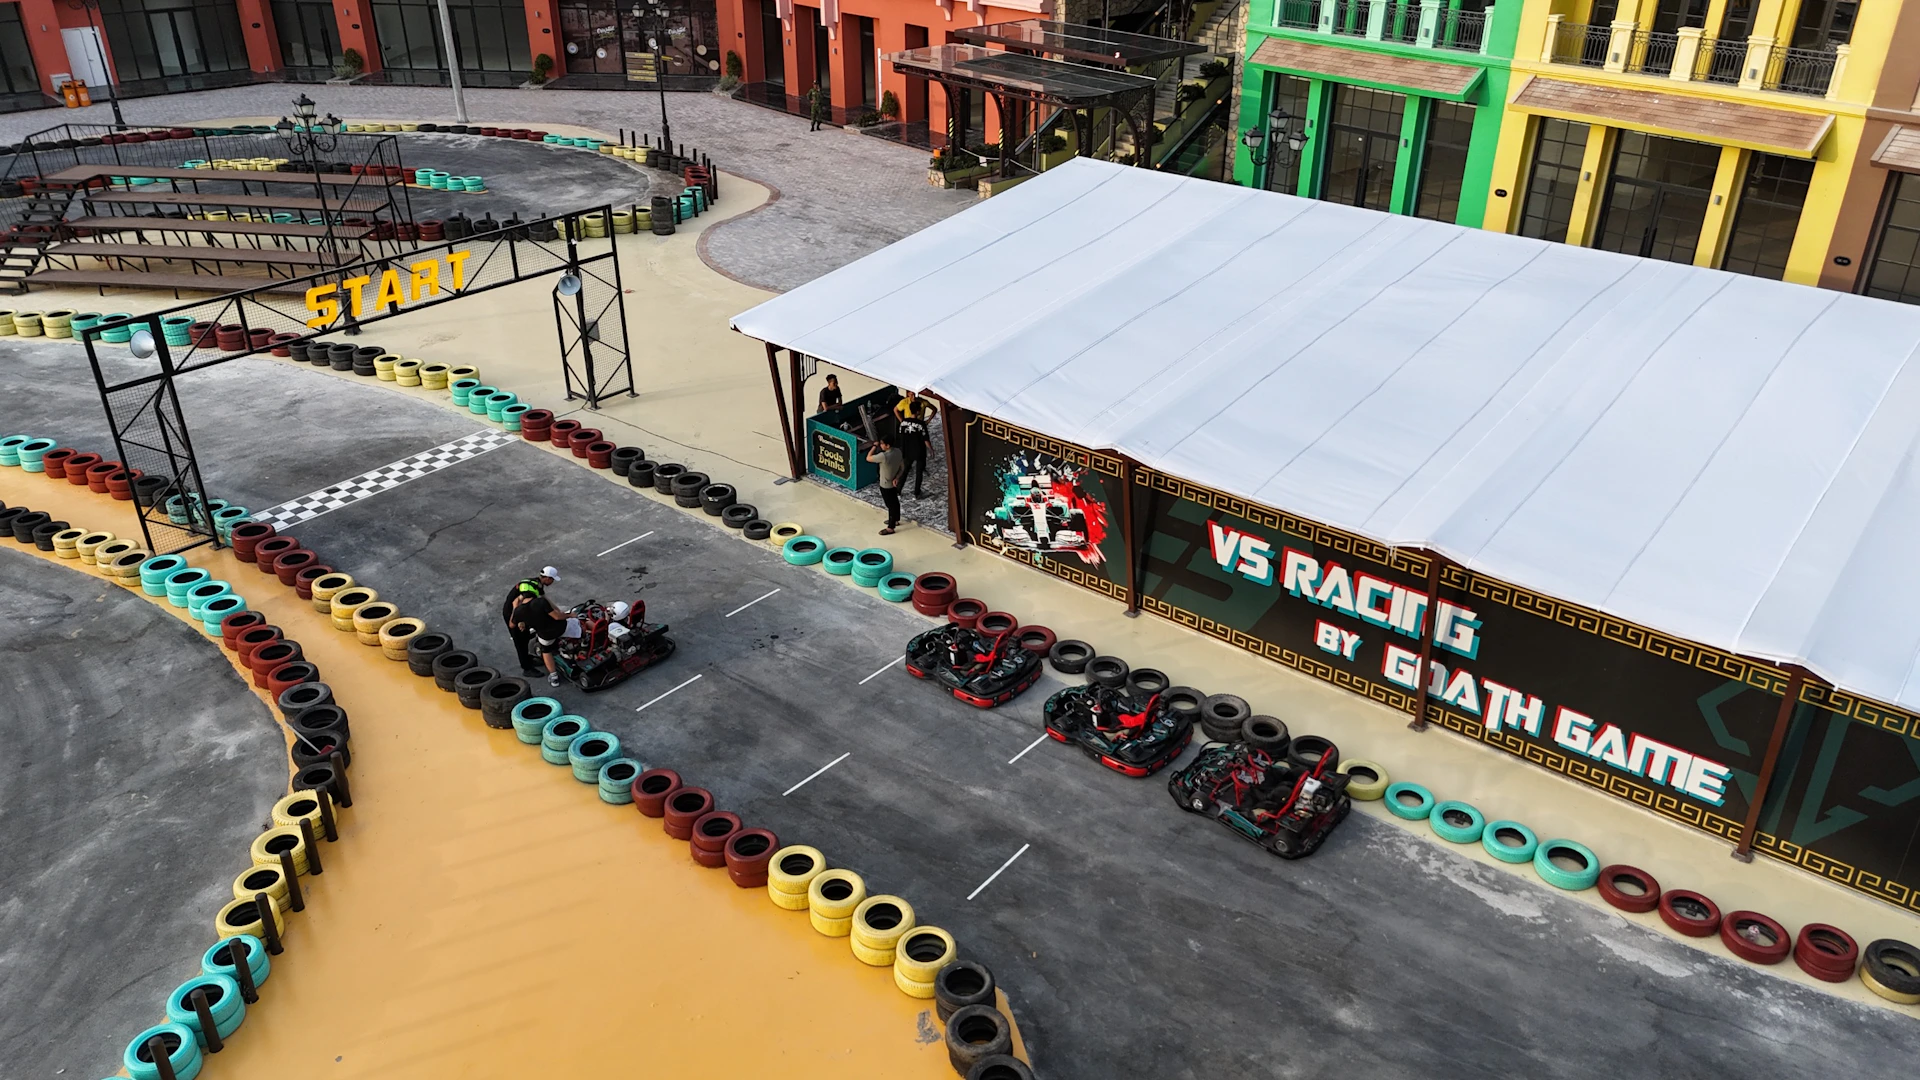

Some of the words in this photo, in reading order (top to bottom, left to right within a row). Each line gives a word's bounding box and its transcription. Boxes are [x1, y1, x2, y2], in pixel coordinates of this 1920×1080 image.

[305, 250, 471, 329] START
[818, 454, 845, 473] Drinks
[819, 446, 844, 463] Foods
[1207, 520, 1276, 587] VS
[1280, 546, 1482, 660] RACING
[1314, 619, 1363, 661] BY
[1381, 643, 1546, 736] GOATH
[1551, 705, 1734, 806] GAME
